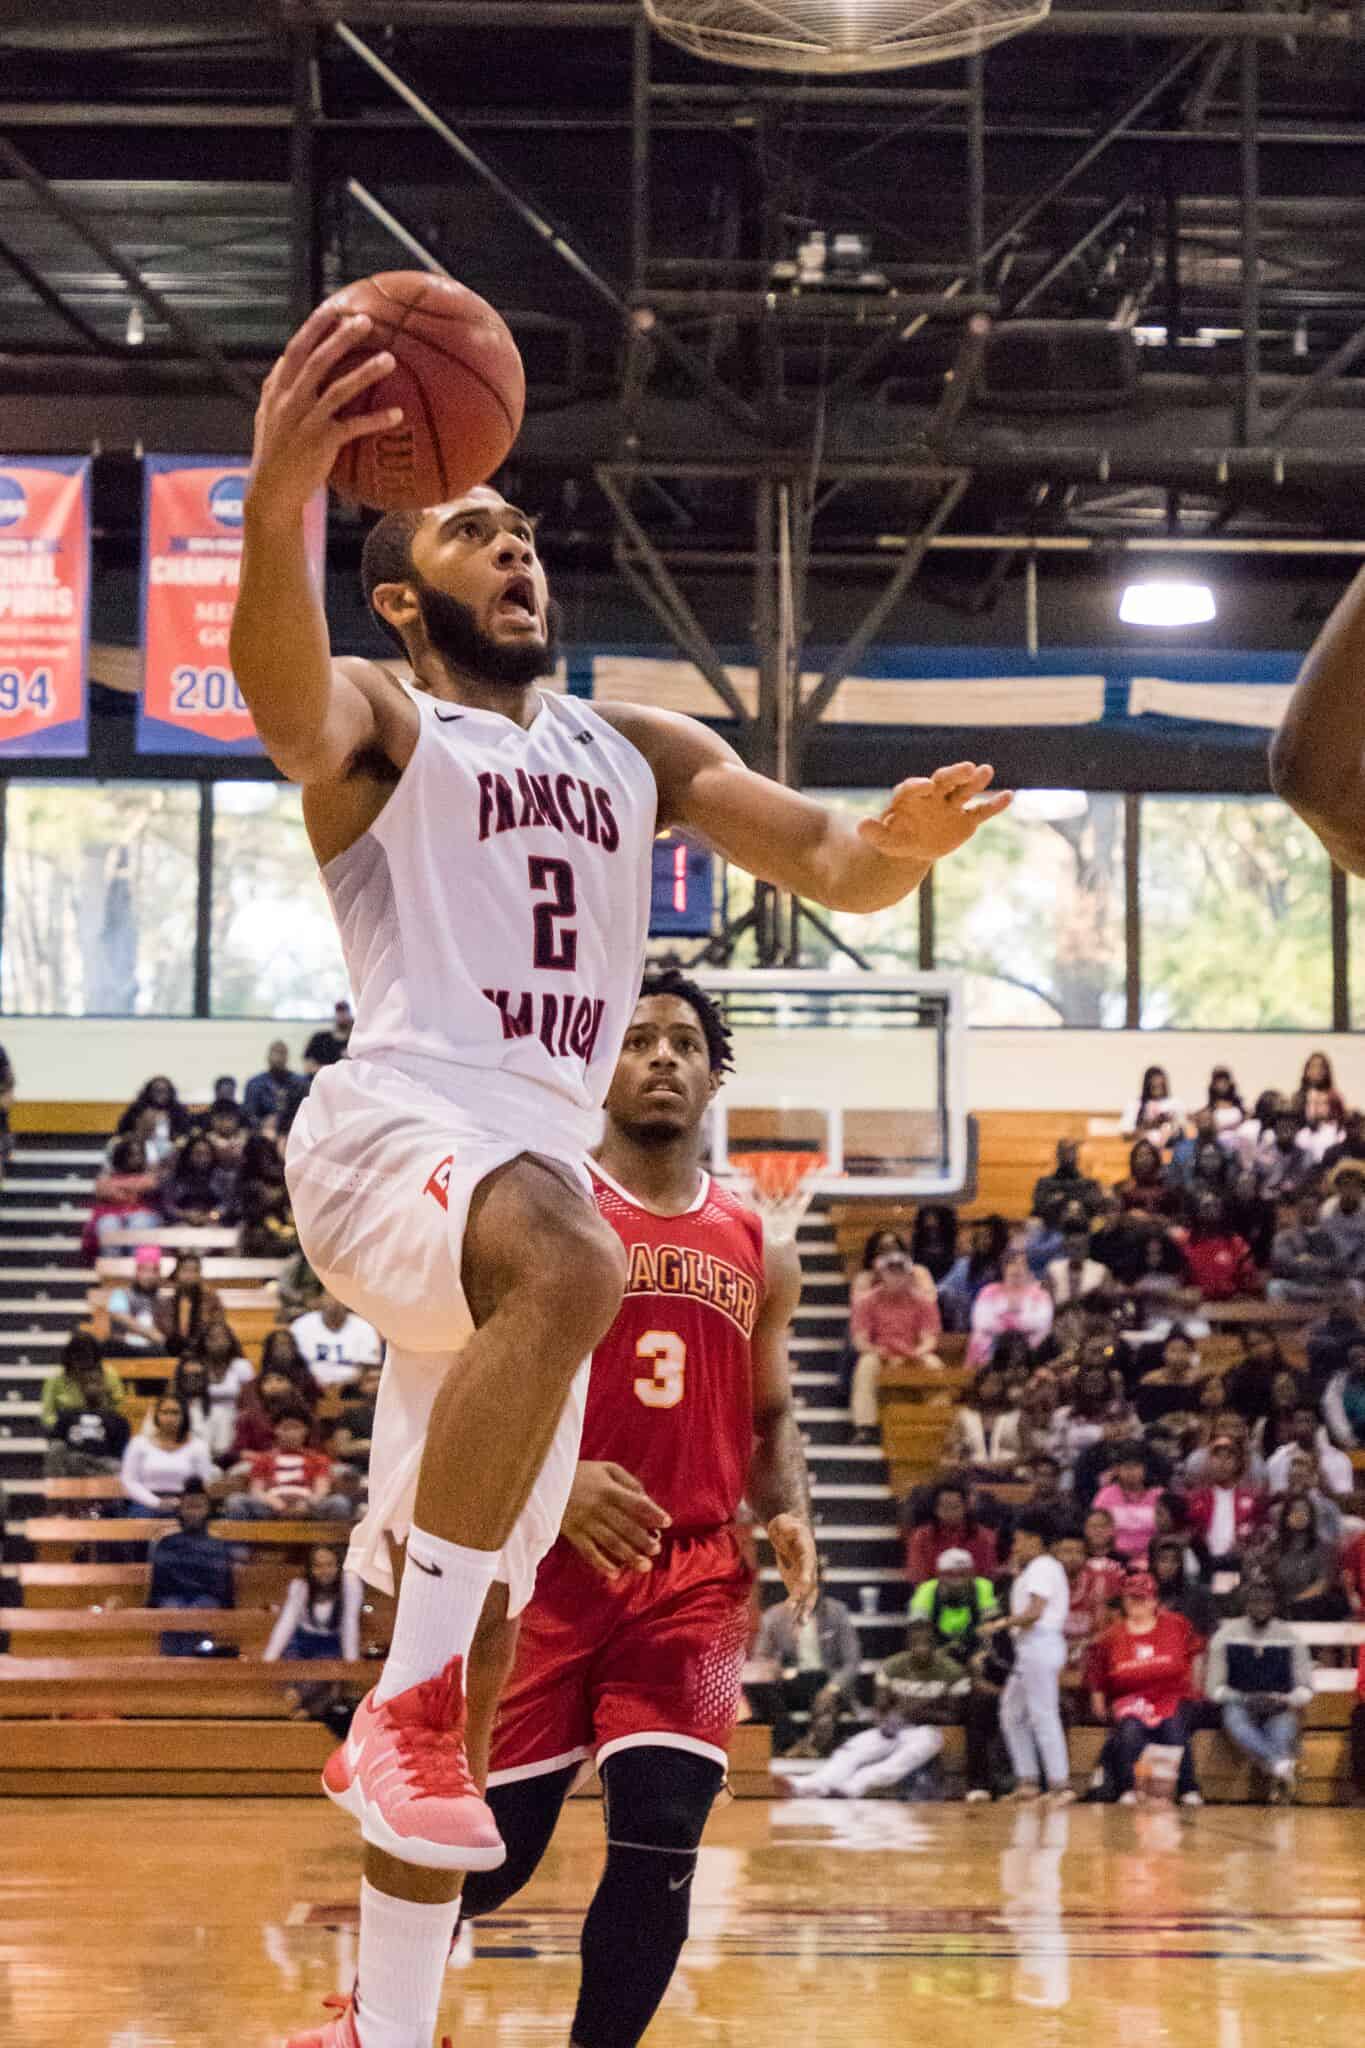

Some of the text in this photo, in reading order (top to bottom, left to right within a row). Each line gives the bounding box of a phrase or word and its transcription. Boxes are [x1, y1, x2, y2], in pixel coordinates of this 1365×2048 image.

[0, 672, 50, 711] 94
[477, 768, 620, 852] FRANCIS
[528, 855, 578, 972] 2
[622, 1243, 757, 1339] AGLER
[633, 1330, 686, 1409] 3
